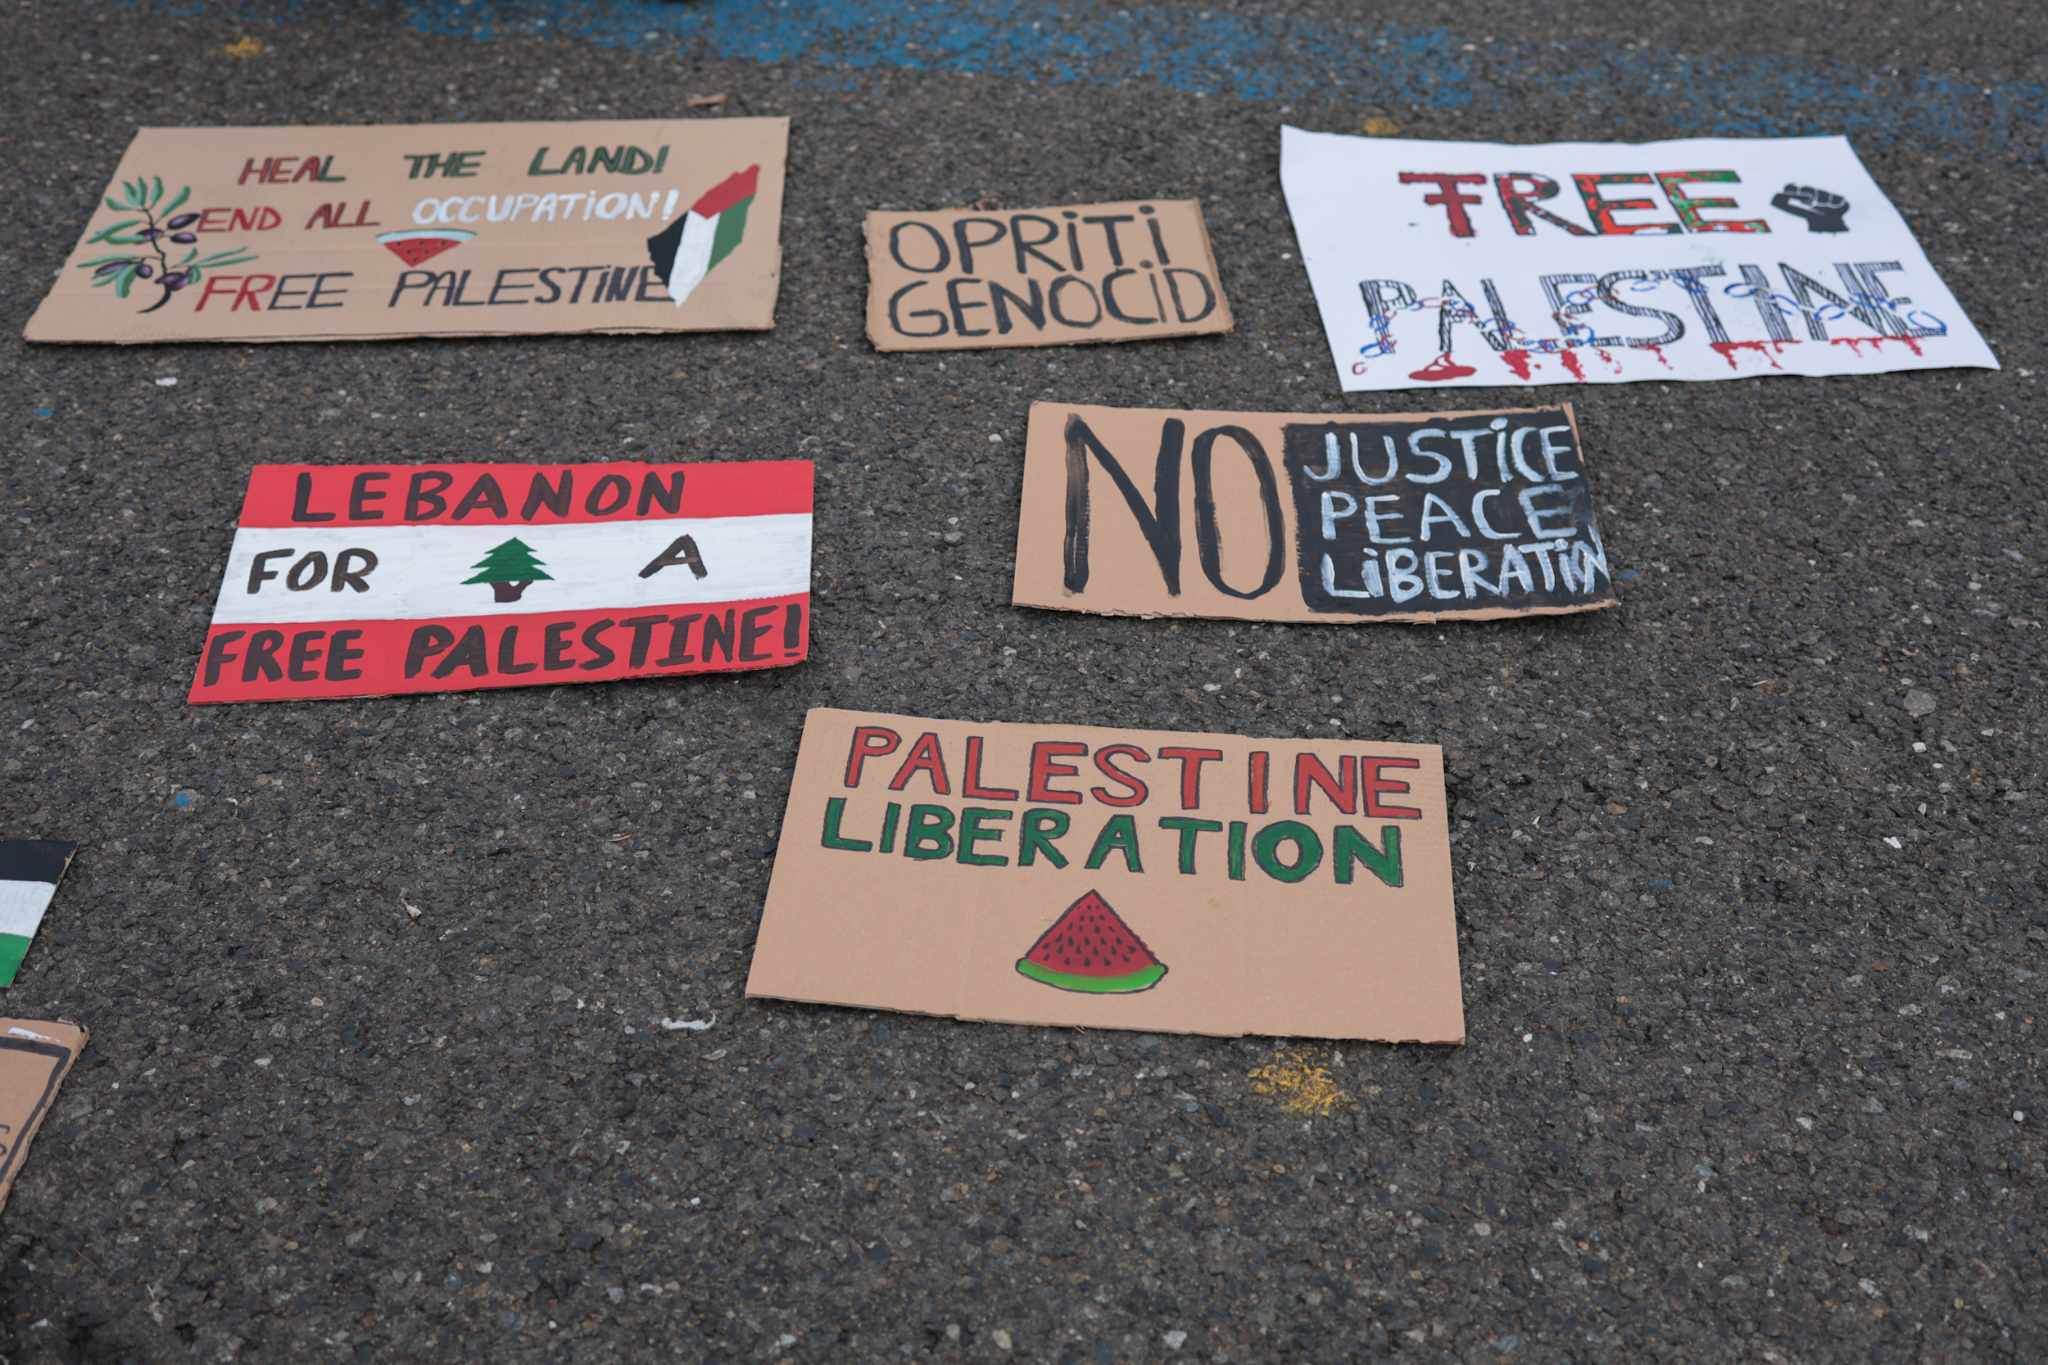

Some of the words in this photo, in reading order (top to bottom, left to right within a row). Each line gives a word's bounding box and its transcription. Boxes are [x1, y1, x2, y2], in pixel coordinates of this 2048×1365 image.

[238, 155, 346, 185] HEAL
[403, 150, 486, 180] THE
[196, 206, 282, 232] END
[305, 200, 381, 230] ALL
[1398, 169, 1771, 238] FREE
[194, 272, 354, 312] FREE
[1358, 260, 1948, 354] PALESTINE
[291, 469, 685, 523] LEBANON
[1064, 413, 1287, 600] NO
[1320, 484, 1578, 543] PEACE
[247, 547, 378, 595] FOR
[638, 534, 708, 580] A
[203, 629, 364, 687] FREE
[403, 604, 802, 680] PALESTINE!
[844, 726, 1422, 819] PALESTINE
[822, 797, 1404, 888] LIBERATION
